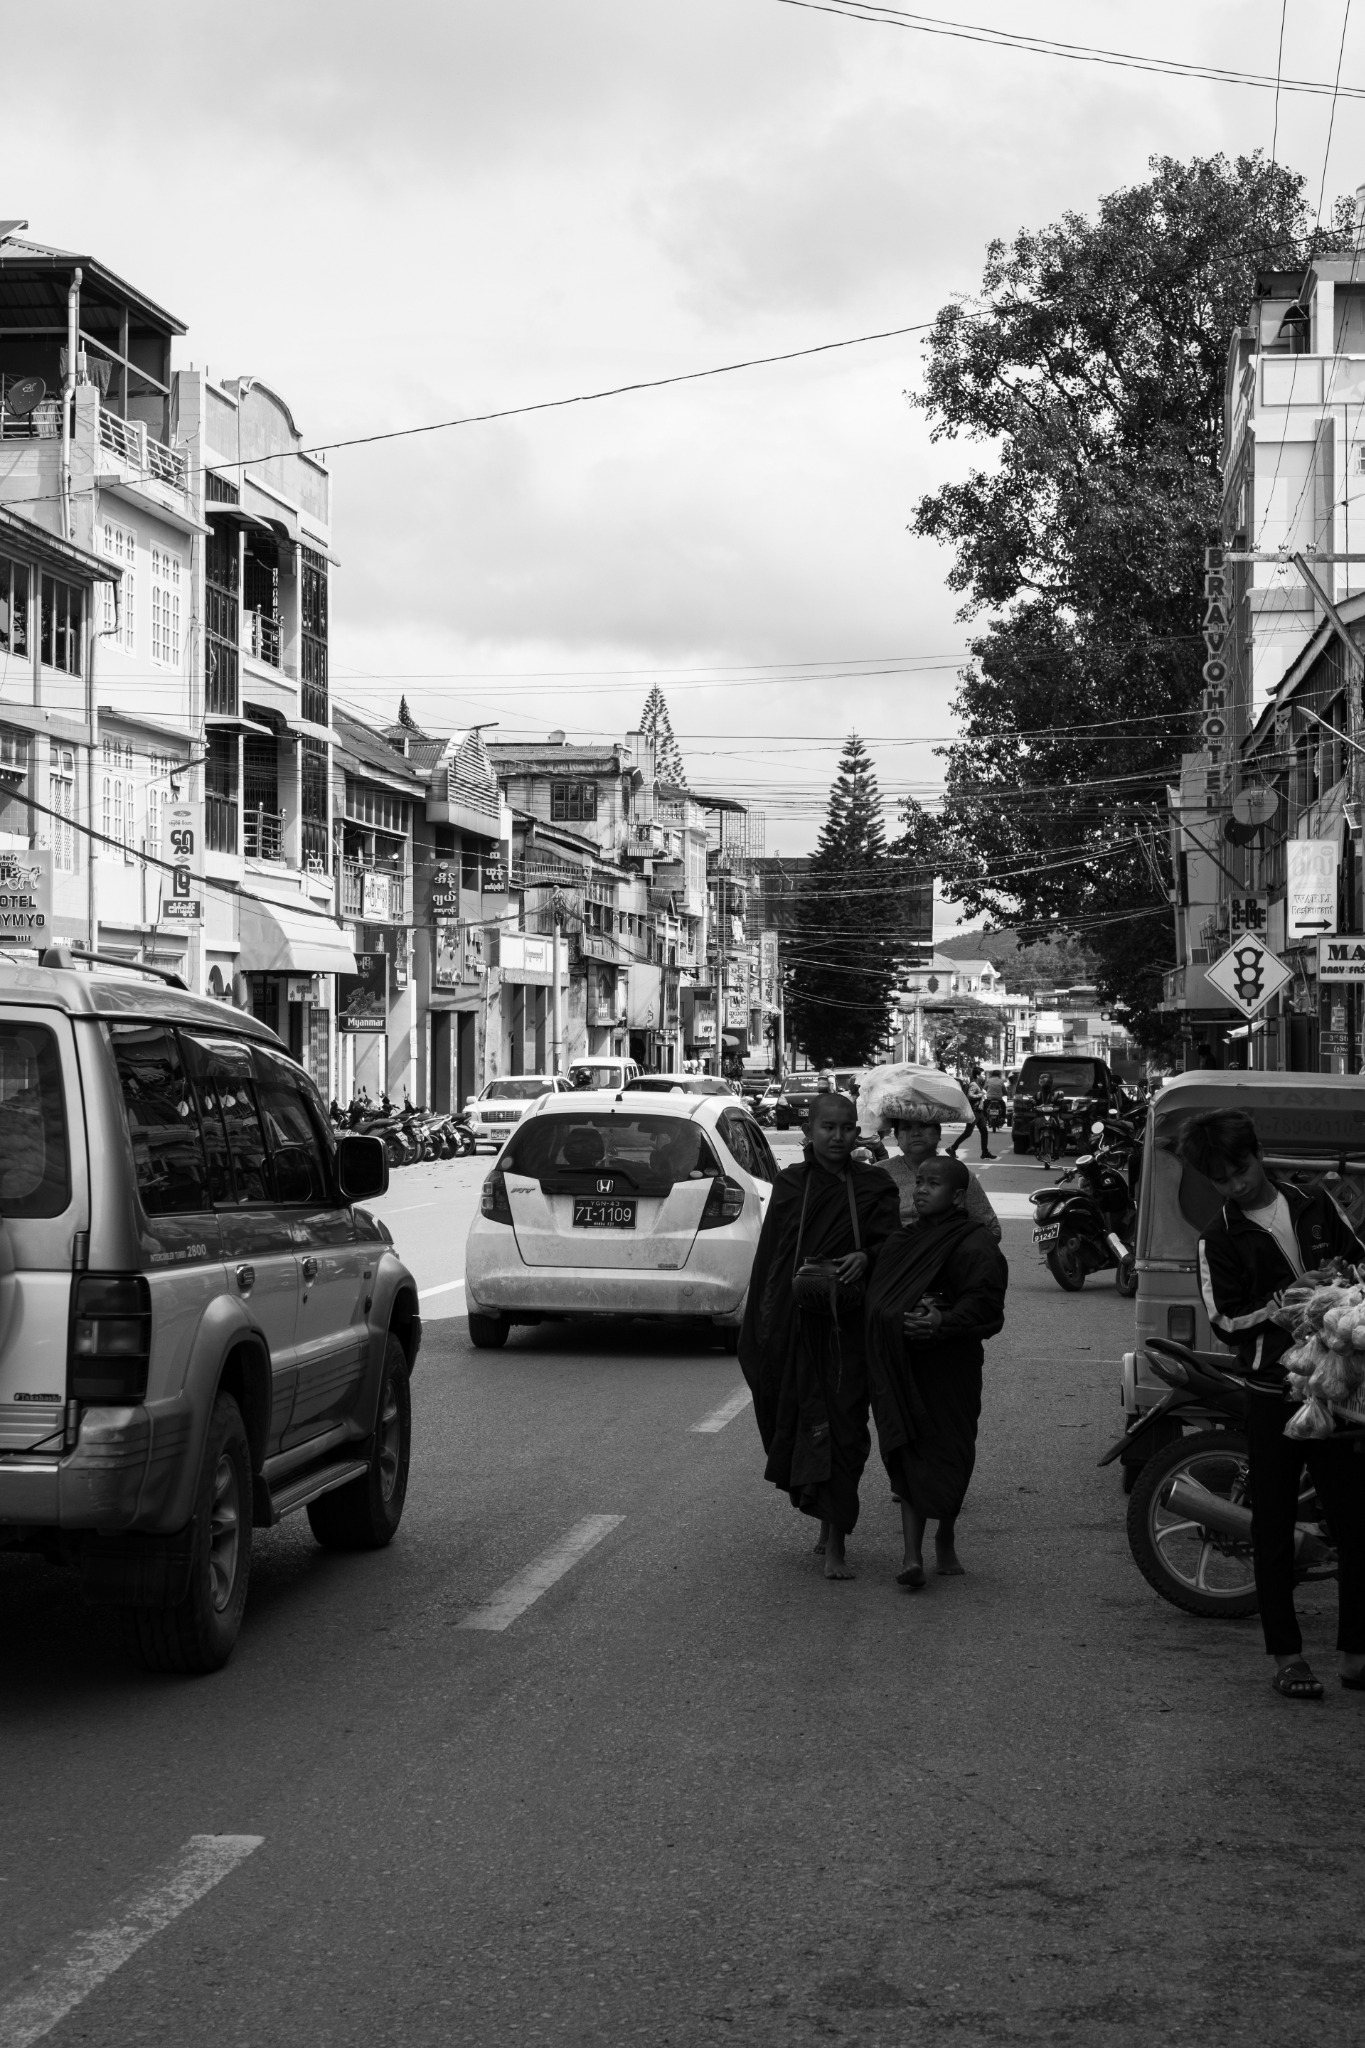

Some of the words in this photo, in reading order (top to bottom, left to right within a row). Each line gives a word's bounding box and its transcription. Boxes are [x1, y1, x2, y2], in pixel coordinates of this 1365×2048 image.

[1202, 547, 1229, 684] BRAVO
[1202, 688, 1227, 816] HOTEL
[1291, 906, 1335, 915] Restaurant
[0, 913, 45, 927] YMYO
[1320, 966, 1345, 974] BABY
[347, 1017, 385, 1029] Myanmar
[1261, 1090, 1341, 1106] TAXI
[575, 1206, 632, 1222] 7I-1109
[186, 1243, 207, 1258] 2800
